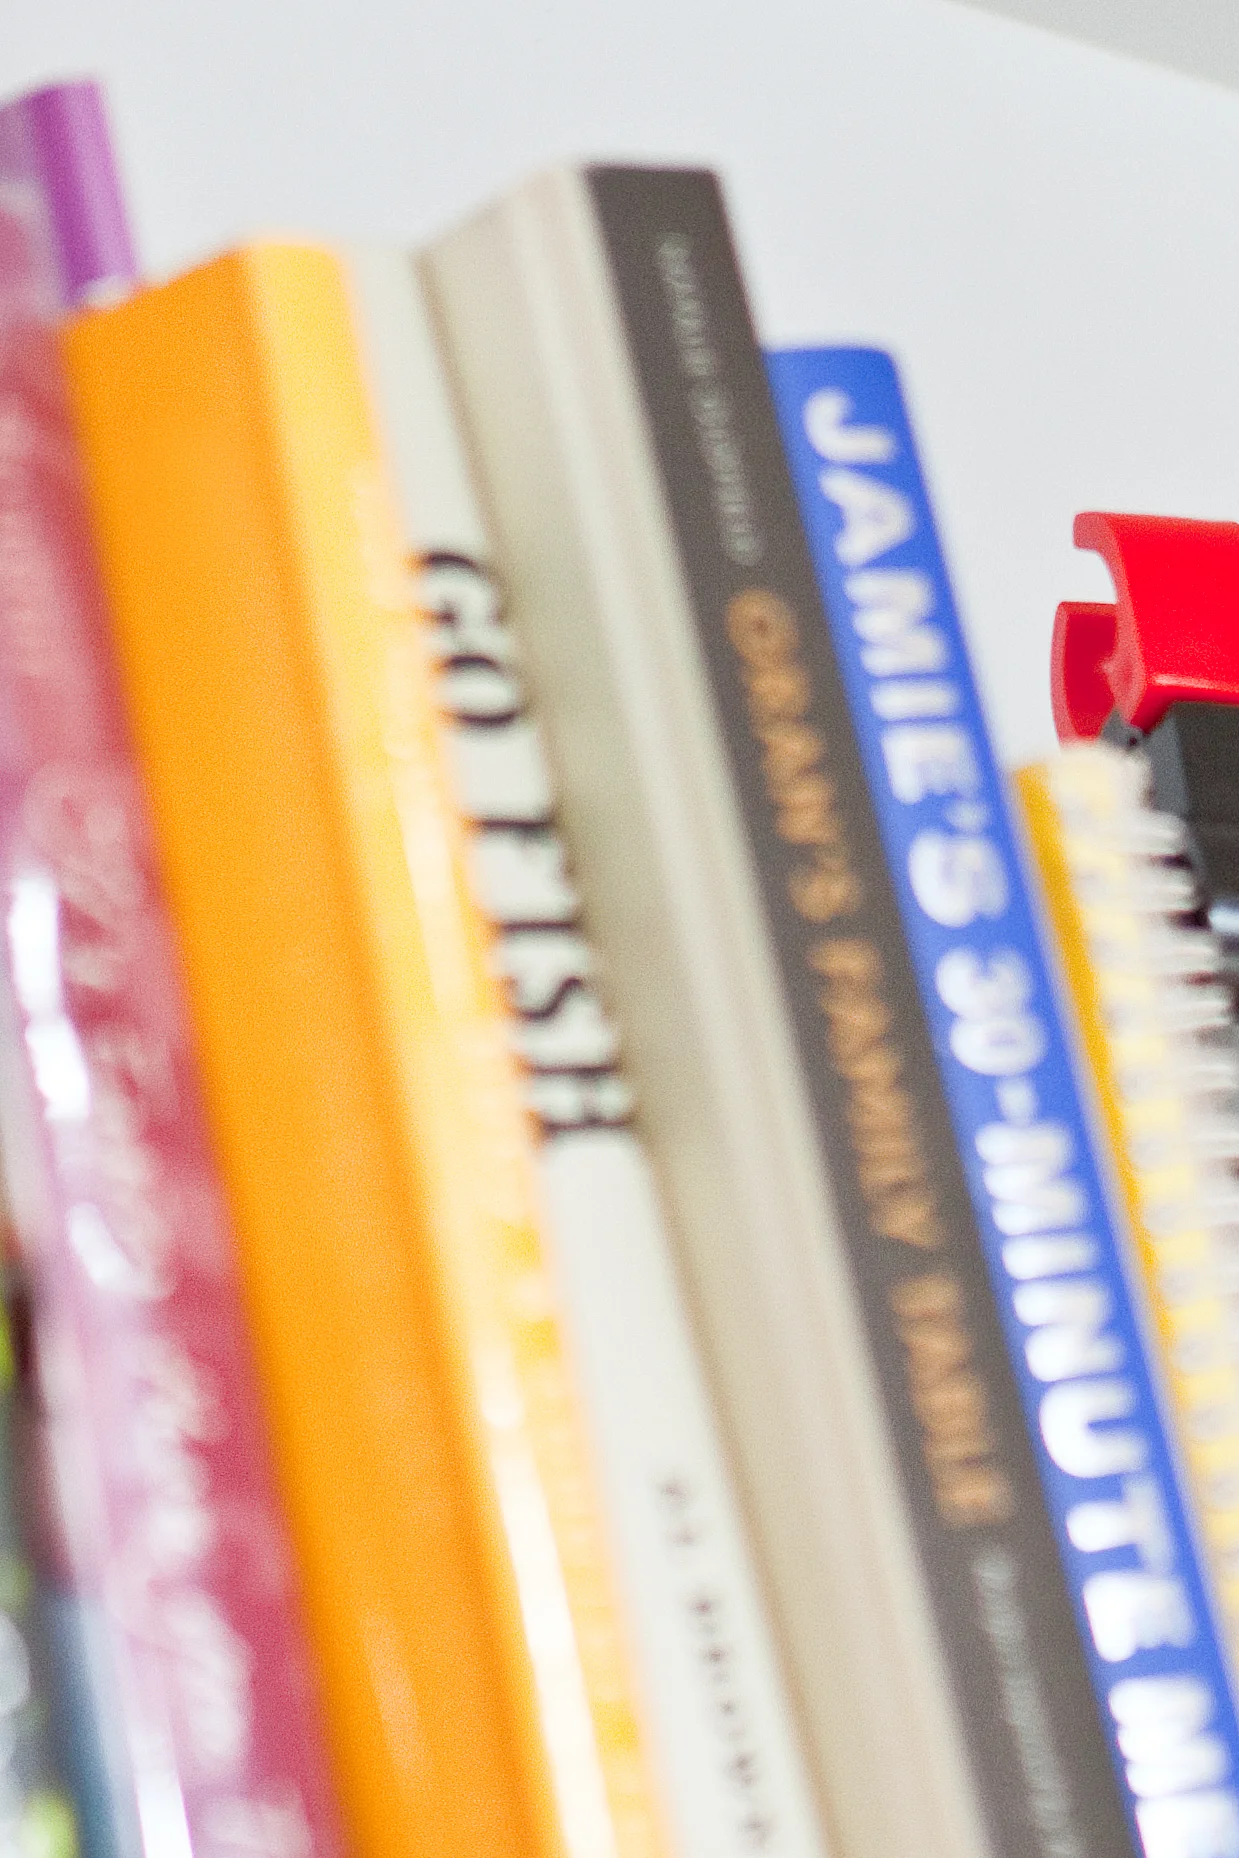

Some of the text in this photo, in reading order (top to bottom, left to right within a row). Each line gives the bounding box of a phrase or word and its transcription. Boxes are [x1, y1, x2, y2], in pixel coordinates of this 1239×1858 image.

[411, 549, 523, 728] GO
[466, 814, 636, 1134] FISH
[724, 587, 1014, 1530] GRAN'S FAMILY TABLE
[803, 387, 1010, 928] JAMIE'S
[935, 946, 1198, 1662] 30-MINUTE
